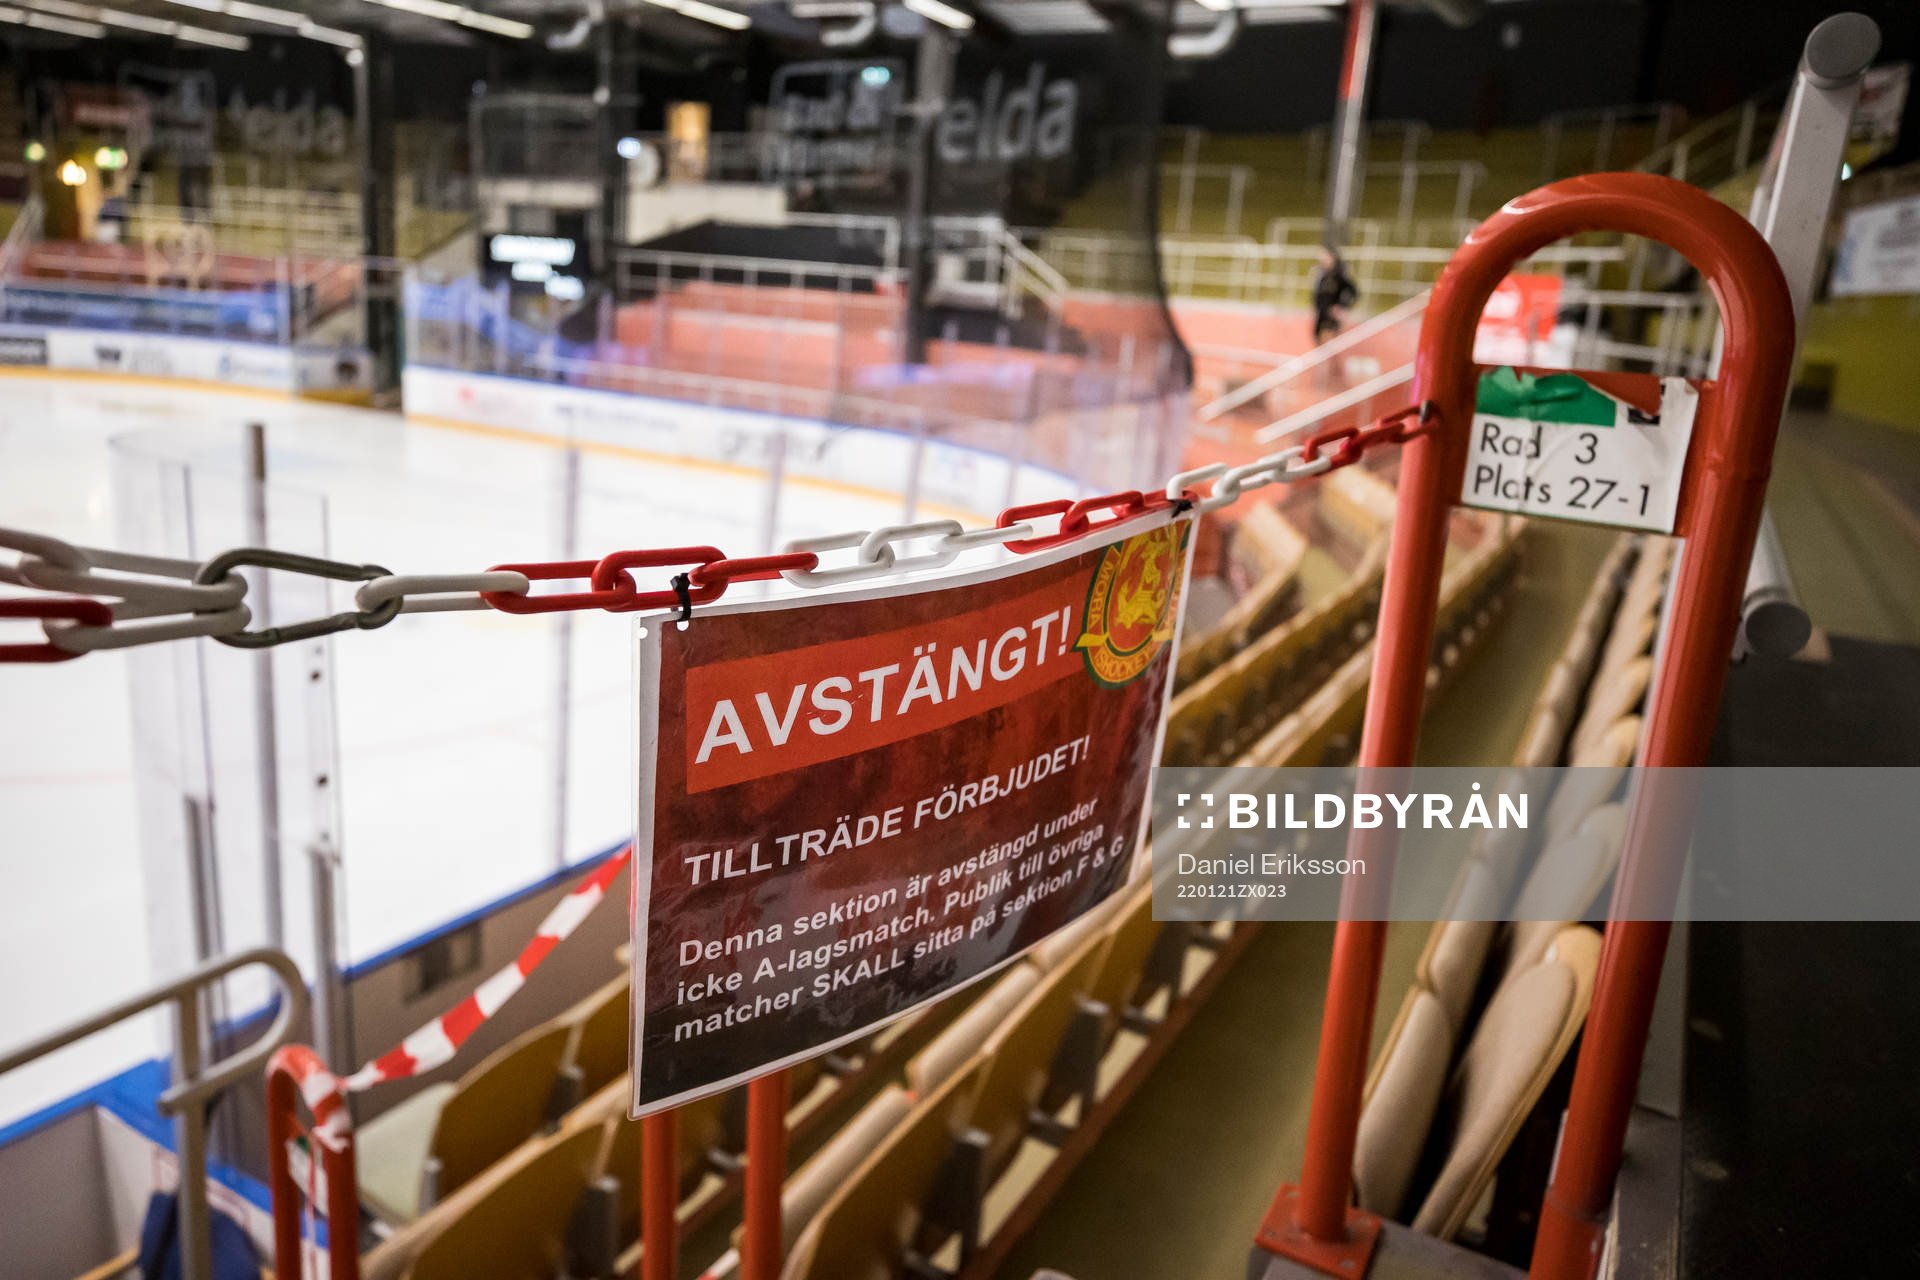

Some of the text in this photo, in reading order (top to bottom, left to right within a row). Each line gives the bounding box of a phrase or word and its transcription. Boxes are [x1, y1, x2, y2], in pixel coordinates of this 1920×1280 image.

[1473, 464, 1650, 516] Plats 27-1
[1480, 423, 1599, 465] Rad 3
[1090, 560, 1114, 629] MORA
[694, 605, 1072, 764] AVSTÄNGT!
[679, 799, 1099, 967] Denna sektion är avstängd under
[684, 735, 1091, 886] TILLTRÄDE FÖRBJUDET!
[674, 835, 1124, 1042] matcher SKALL sitta på sektion F & G
[677, 825, 1104, 1005] icke A-lagsmatch. Publik till övriga
